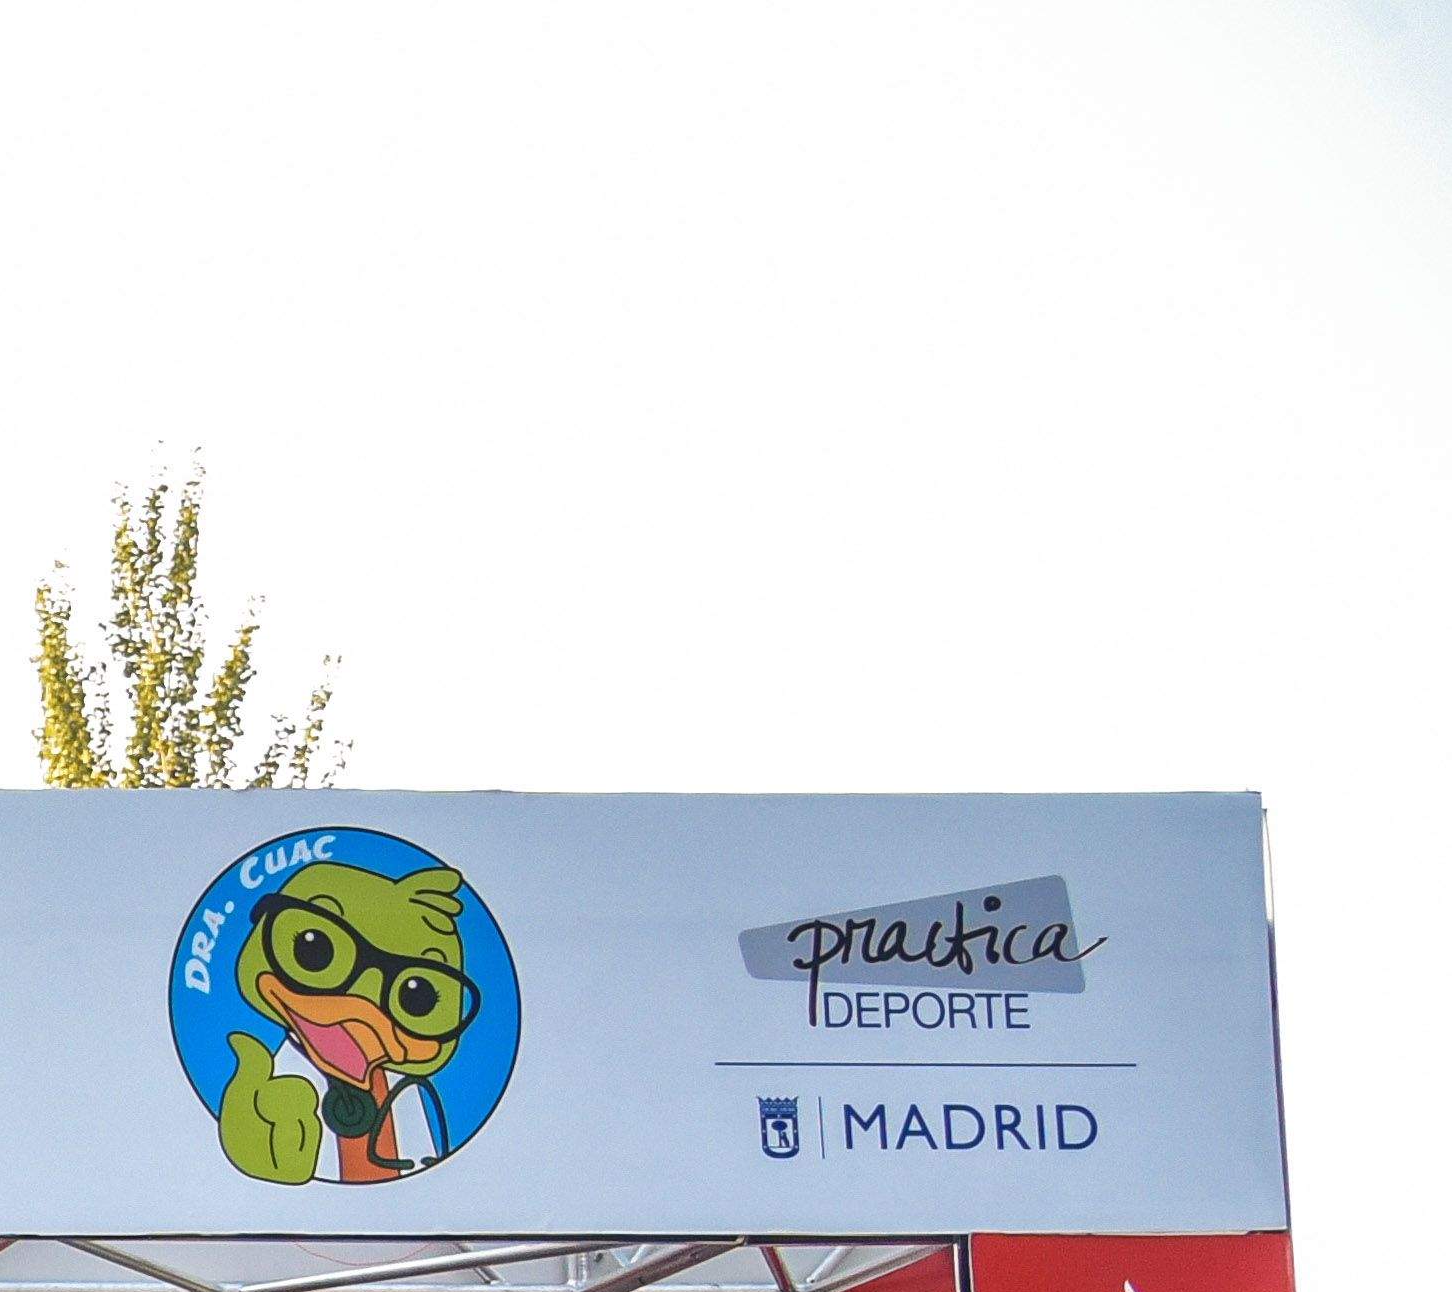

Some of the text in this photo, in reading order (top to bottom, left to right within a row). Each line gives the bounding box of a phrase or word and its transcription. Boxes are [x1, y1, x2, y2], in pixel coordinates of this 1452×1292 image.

[183, 834, 337, 995] DRA. CUAC
[823, 991, 1031, 1030] DEPORTE
[844, 1102, 1099, 1153] MADRID
